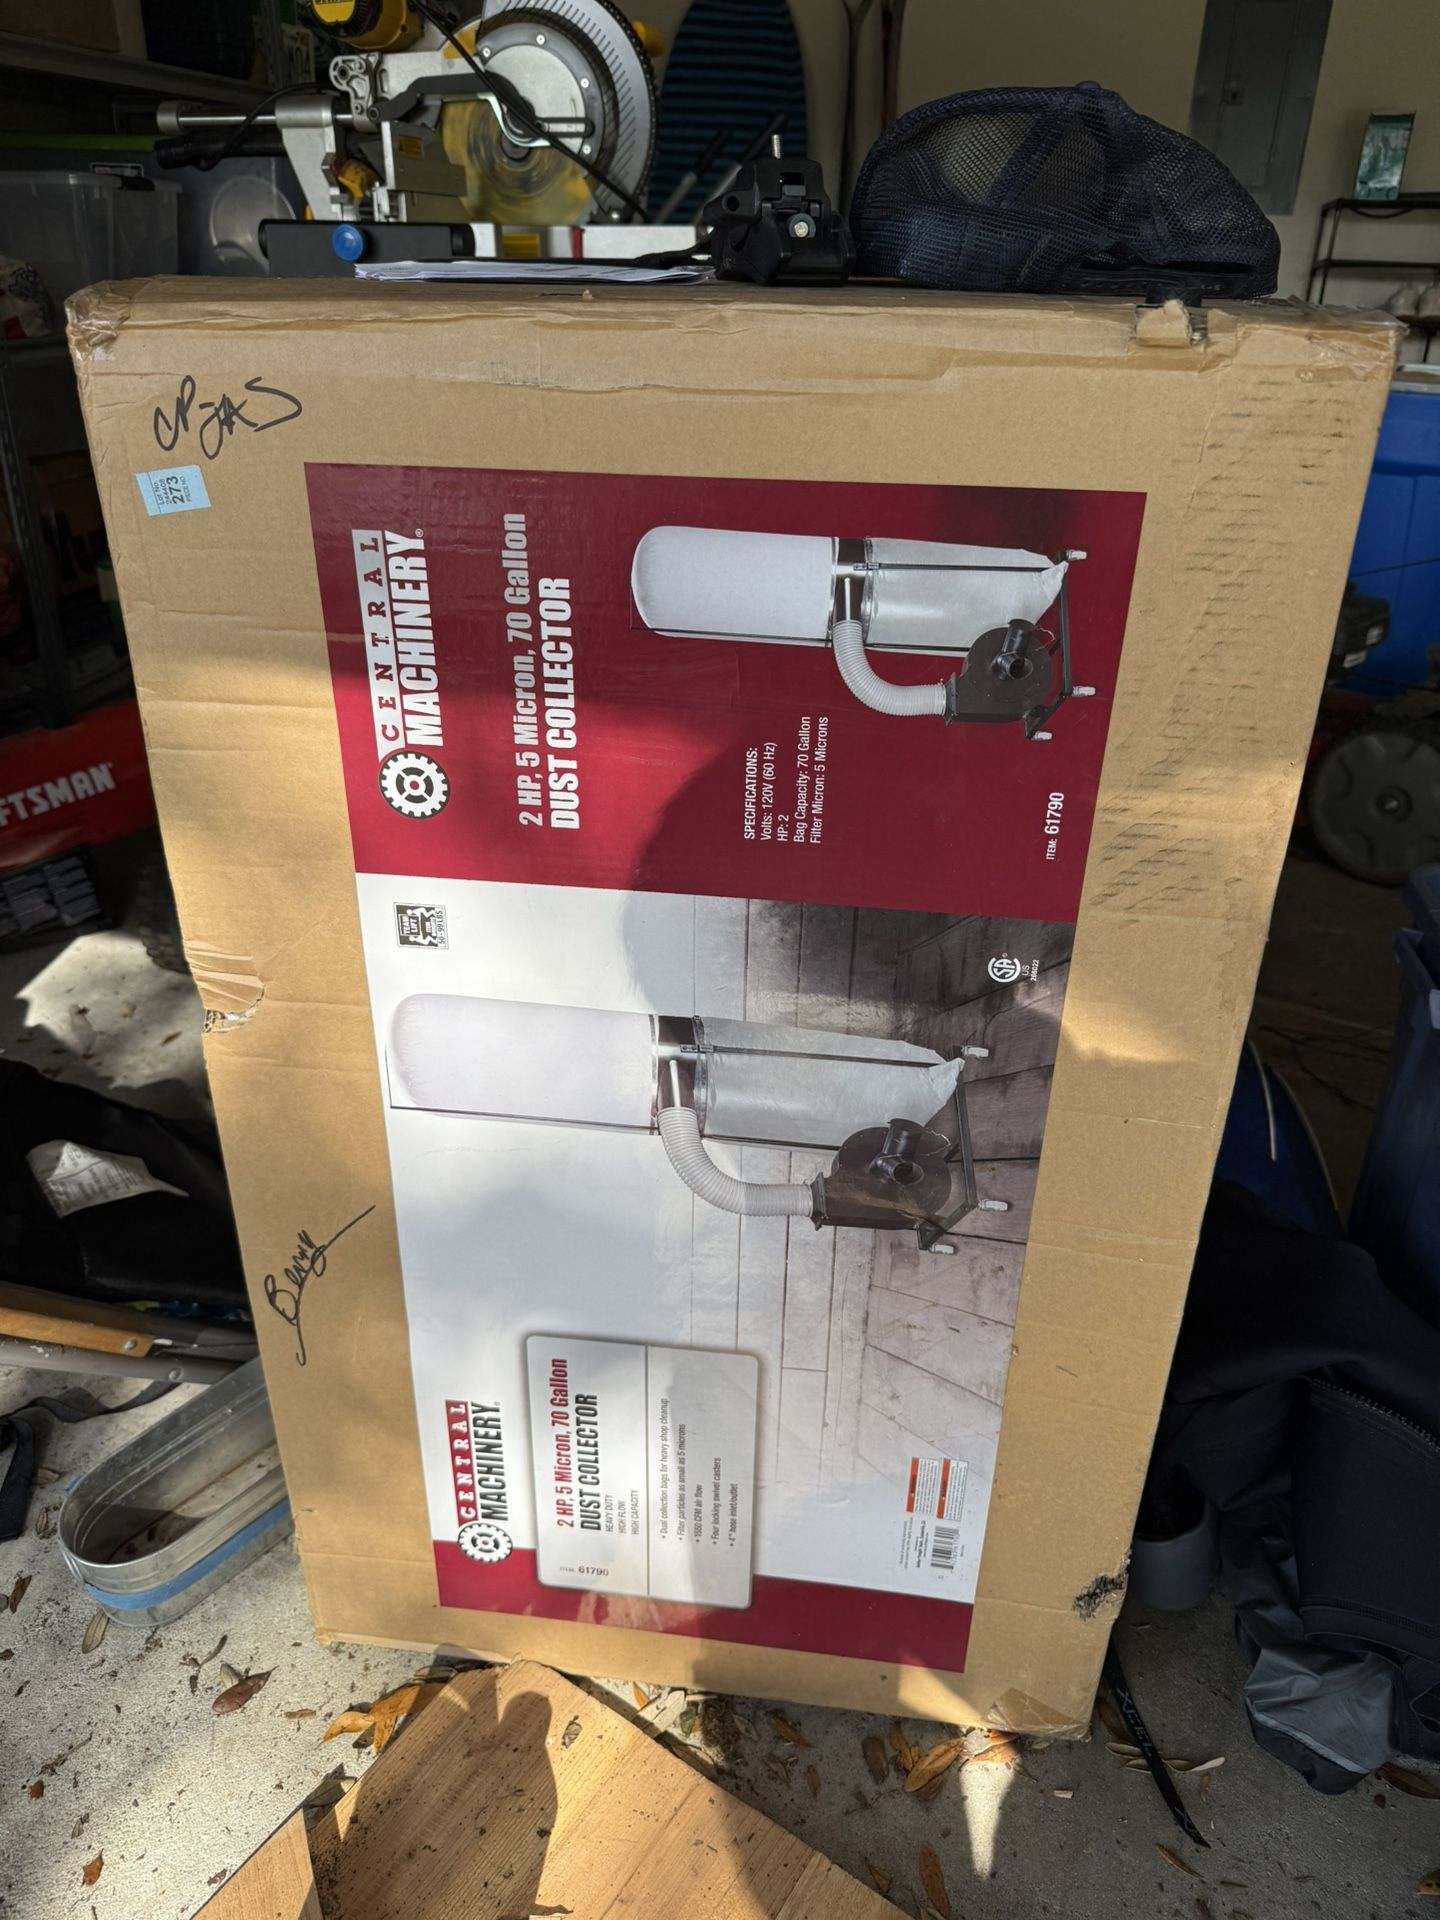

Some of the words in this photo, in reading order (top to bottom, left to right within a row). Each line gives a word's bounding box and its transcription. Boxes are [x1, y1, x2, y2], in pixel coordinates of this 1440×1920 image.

[166, 476, 185, 504] 273
[182, 486, 192, 502] PIECE
[501, 514, 531, 605] Gallon
[506, 612, 533, 642] 70
[360, 537, 399, 742] CENTRAL
[384, 530, 444, 747] MACHINERY
[537, 577, 577, 749] COLLECTOR
[510, 649, 538, 745] Micron,
[798, 716, 811, 751] Gallon
[815, 717, 828, 761] Microns
[514, 752, 540, 768] 5
[764, 742, 777, 759] Hz)
[797, 754, 808, 768] 70
[763, 763, 776, 780] (60
[0, 762, 116, 828] FTSMAN
[515, 774, 543, 806] HP,
[547, 754, 580, 829] DUST
[744, 747, 758, 839] SPECIFICATIONS:
[762, 783, 774, 809] 120V
[794, 771, 810, 819] Capacity:
[812, 774, 824, 814] Micron:
[518, 812, 543, 826] 2
[1044, 792, 1065, 835] 61790
[760, 813, 772, 840] Volts:
[777, 824, 789, 841] HP:
[794, 822, 808, 842] Bag
[810, 817, 822, 844] Filter
[1045, 838, 1058, 860] ITEM:
[402, 916, 410, 934] TEAM
[410, 918, 418, 932] LIFT
[988, 957, 1021, 983] CSA
[1022, 965, 1030, 976] US
[550, 1359, 568, 1407] Gallon
[551, 1410, 569, 1427] 70
[660, 1398, 669, 1424] cleanup
[575, 1393, 599, 1486] COLLECTOR
[660, 1425, 669, 1441] shop
[678, 1424, 686, 1450] microns
[450, 1404, 476, 1519] CENTRAL
[471, 1401, 508, 1521] MACHINERY
[552, 1431, 572, 1482] Micron,
[660, 1443, 669, 1462] heavy
[679, 1457, 686, 1465] as
[660, 1463, 668, 1472] for
[677, 1466, 686, 1483] small
[713, 1457, 721, 1481] casters
[555, 1486, 572, 1494] 5
[661, 1473, 670, 1488] bags
[679, 1484, 686, 1492] as
[695, 1484, 703, 1498] flow
[712, 1482, 720, 1501] swivel
[728, 1483, 738, 1517] inlet/outlet
[555, 1498, 574, 1516] HP,
[579, 1489, 601, 1531] DUST
[604, 1495, 613, 1512] DUTY
[617, 1501, 626, 1519] FLOW
[630, 1489, 639, 1519] CAPACITY
[660, 1489, 668, 1519] collection
[677, 1493, 687, 1519] particles
[695, 1499, 703, 1507] air
[556, 1520, 574, 1528] 2
[604, 1512, 614, 1532] HEAVY
[712, 1503, 722, 1525] locking
[618, 1520, 627, 1533] HIGH
[631, 1521, 639, 1535] HIGH
[660, 1520, 668, 1534] Dual
[677, 1520, 685, 1536] Filter
[712, 1526, 720, 1540] Four
[728, 1518, 736, 1532] hose
[578, 1565, 609, 1577] 61790
